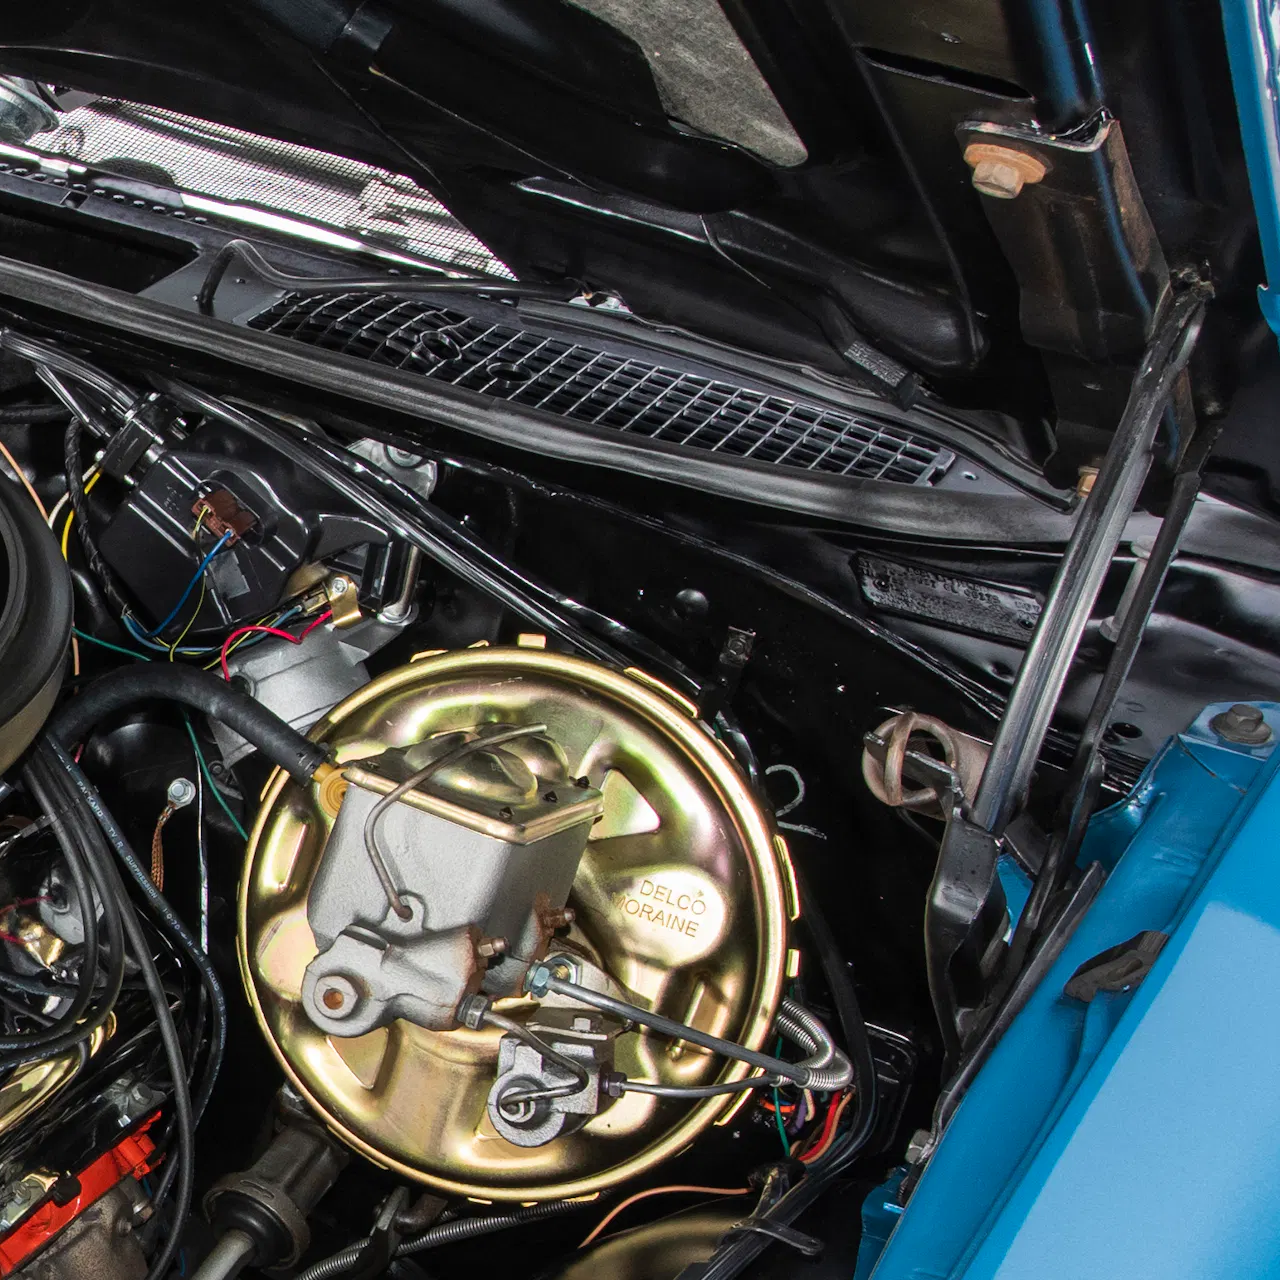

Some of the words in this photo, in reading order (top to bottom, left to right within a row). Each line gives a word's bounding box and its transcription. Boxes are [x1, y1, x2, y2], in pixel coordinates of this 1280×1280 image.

[125, 855, 158, 899] SUPPRESSION
[640, 880, 706, 915] DELCO
[612, 892, 699, 937] MORAINE
